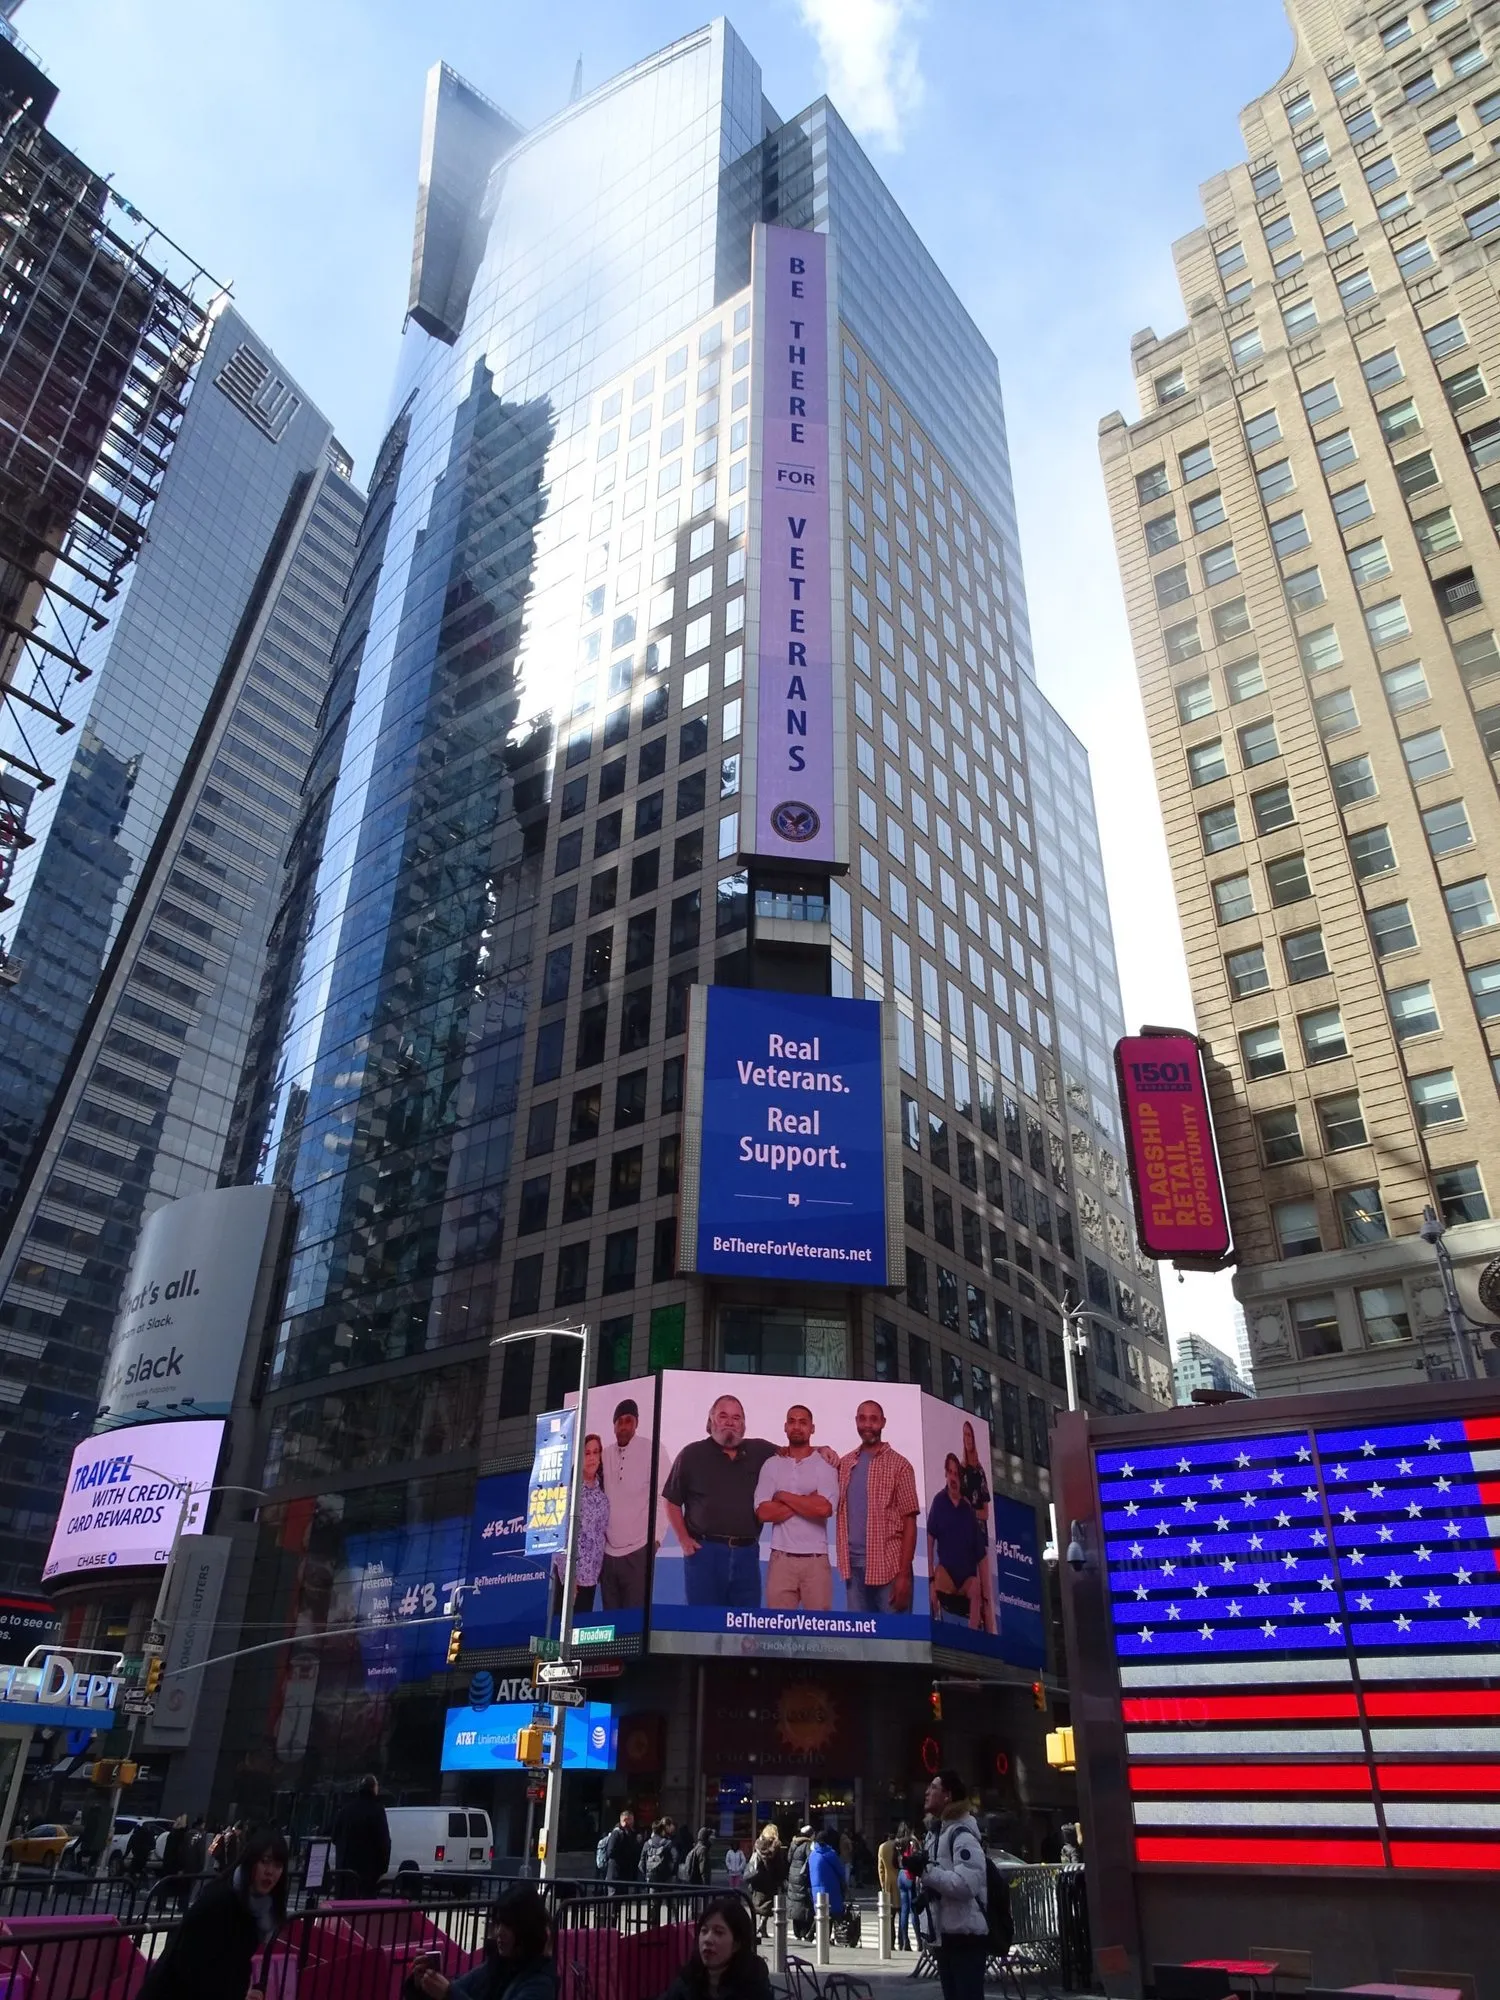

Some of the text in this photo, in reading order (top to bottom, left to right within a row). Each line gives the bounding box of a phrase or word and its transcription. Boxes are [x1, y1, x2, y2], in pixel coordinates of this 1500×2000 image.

[789, 257, 806, 444] BE THERE
[777, 469, 815, 487] FOR
[787, 516, 807, 772] VETERANS
[768, 1033, 820, 1061] Real
[737, 1060, 850, 1093] Veterans.
[1130, 1062, 1190, 1082] 1501
[767, 1106, 820, 1136] Real
[739, 1136, 847, 1171] Support.
[1138, 1102, 1174, 1226] FLAGSHIP
[1182, 1104, 1214, 1227] OPPORTUNITY
[1166, 1140, 1196, 1226] RETAIL
[713, 1236, 872, 1262] BeThereForVeterans.net
[165, 1269, 200, 1301] all.
[146, 1313, 174, 1331] Slack.
[124, 1346, 185, 1386] slack
[71, 1454, 134, 1495] TRAVEL
[538, 1468, 562, 1483] STORY
[92, 1482, 188, 1509] WITH CREDIT
[530, 1485, 568, 1502] COME
[67, 1505, 165, 1535] CARD REWARDS
[527, 1511, 566, 1531] AWAY
[77, 1553, 108, 1568] CHASE
[192, 1564, 211, 1618] REUTERS
[474, 1571, 546, 1588] BeThereForVeterans.net
[10, 1614, 21, 1626] to
[23, 1617, 43, 1629] see
[726, 1612, 877, 1634] BeThereForVeterans.net
[580, 1628, 613, 1642] Broadway
[543, 1669, 556, 1678] ONE
[561, 1666, 576, 1676] WAY
[496, 1677, 540, 1702] AT&T
[553, 1691, 581, 1701] ONE WAY
[455, 1731, 478, 1746] AT&T
[477, 1733, 511, 1745] Unlimited
